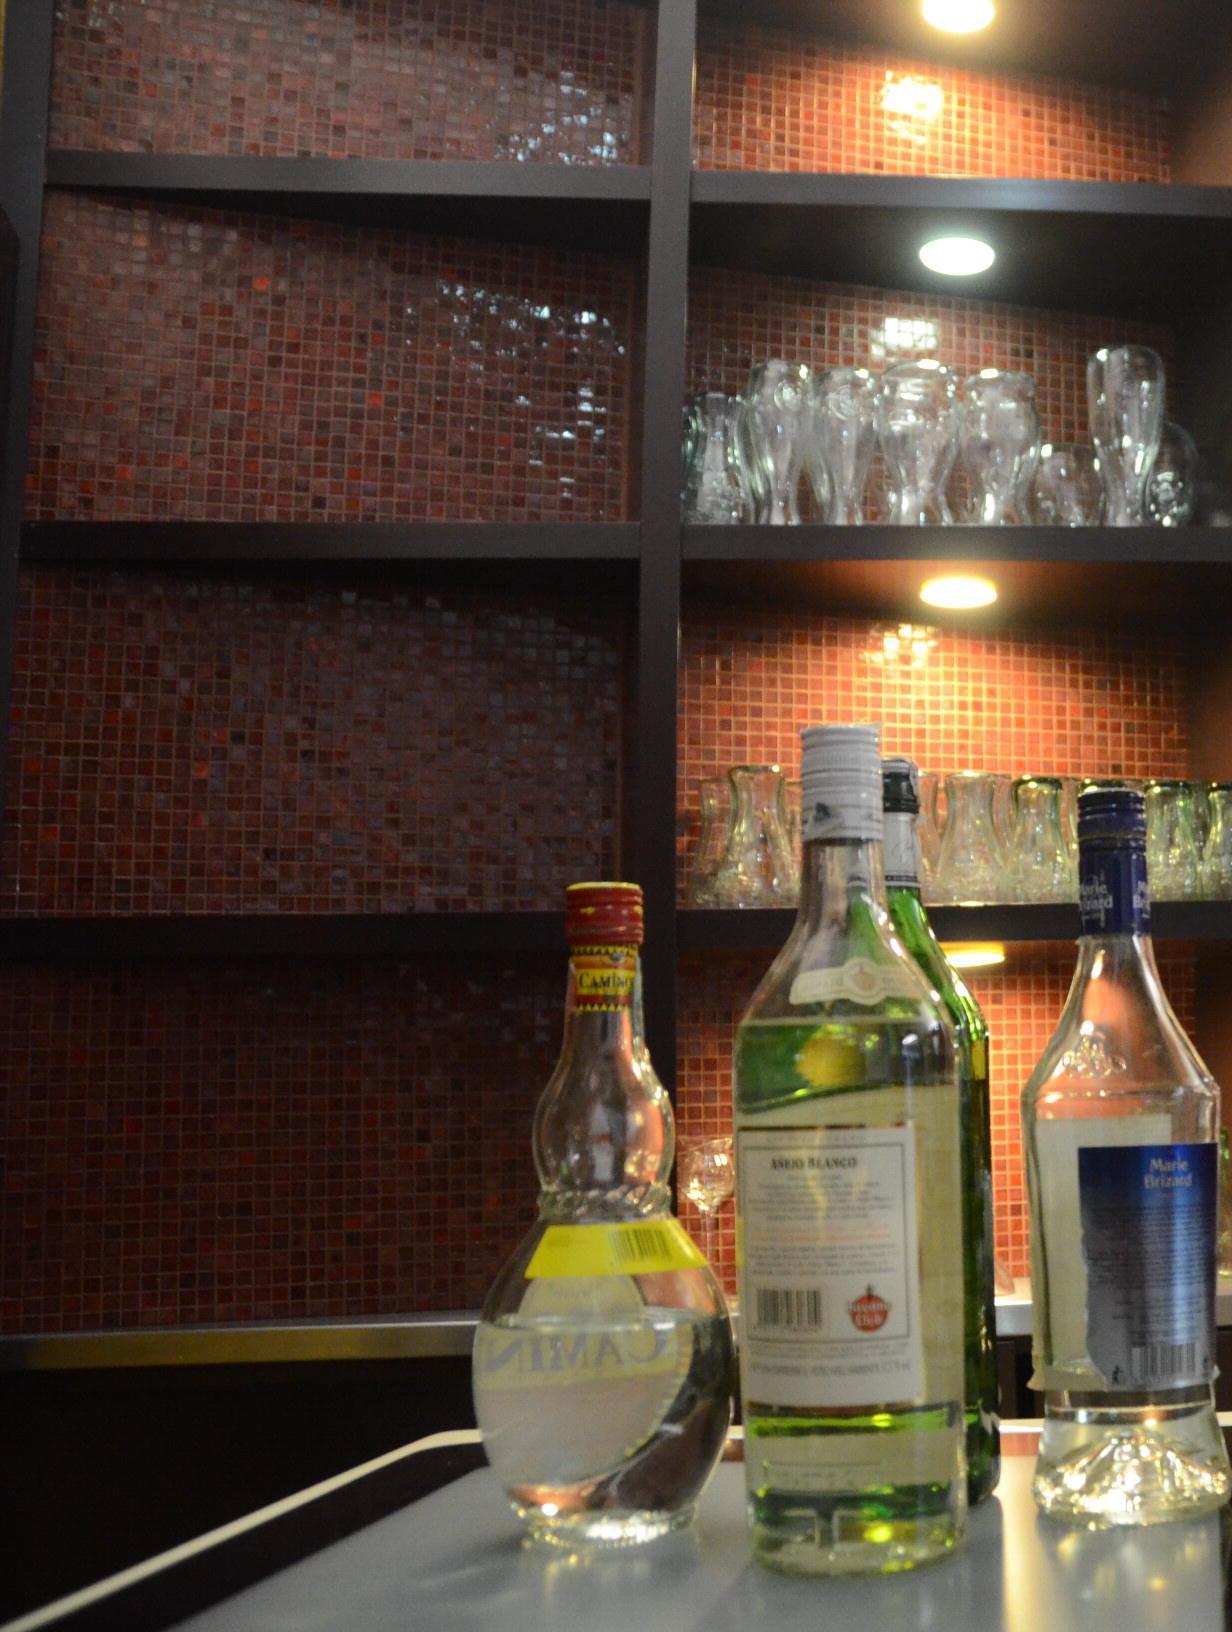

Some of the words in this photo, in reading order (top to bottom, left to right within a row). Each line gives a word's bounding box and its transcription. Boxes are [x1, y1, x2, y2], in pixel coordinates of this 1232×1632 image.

[807, 1156, 858, 1170] BLANCO
[1151, 1158, 1189, 1172] Marie
[1143, 1173, 1193, 1189] Brizard
[855, 1313, 883, 1326] Club
